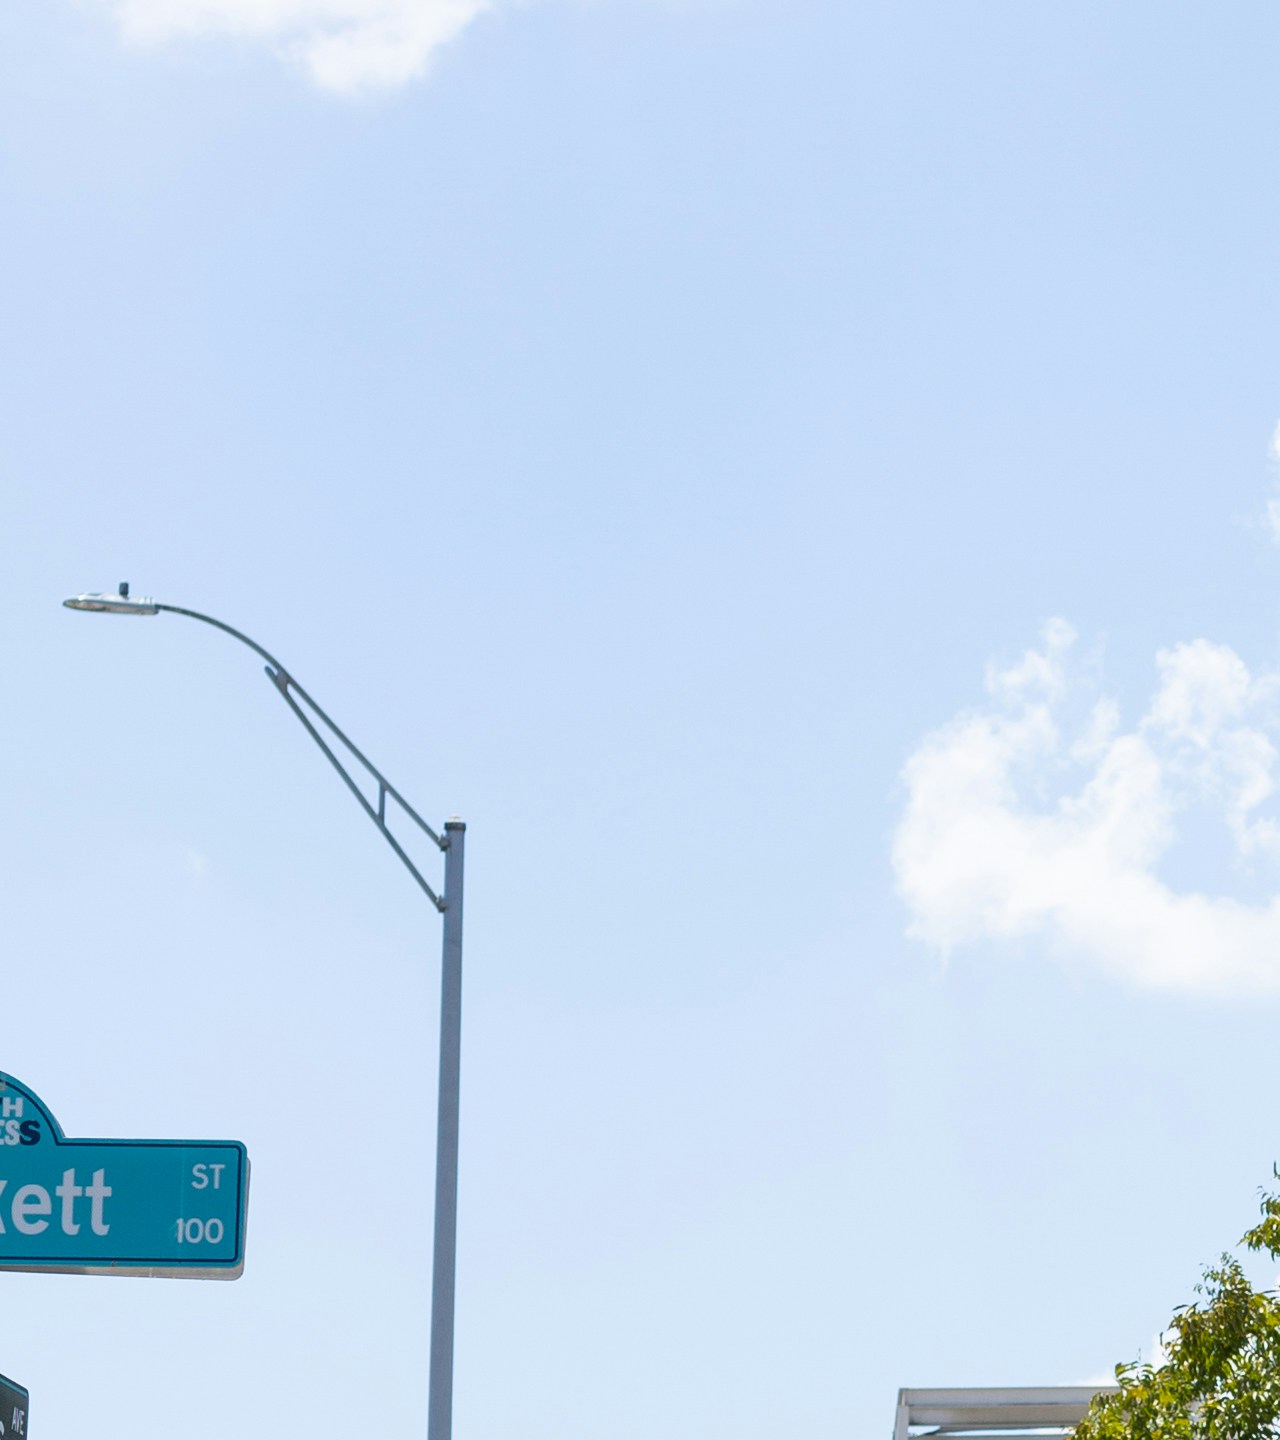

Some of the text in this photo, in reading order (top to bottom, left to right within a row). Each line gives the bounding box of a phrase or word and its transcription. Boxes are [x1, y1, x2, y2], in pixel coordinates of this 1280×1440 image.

[192, 1163, 226, 1190] ST
[0, 1167, 113, 1236] ett
[175, 1217, 225, 1245] 100
[11, 1406, 25, 1436] AVE
